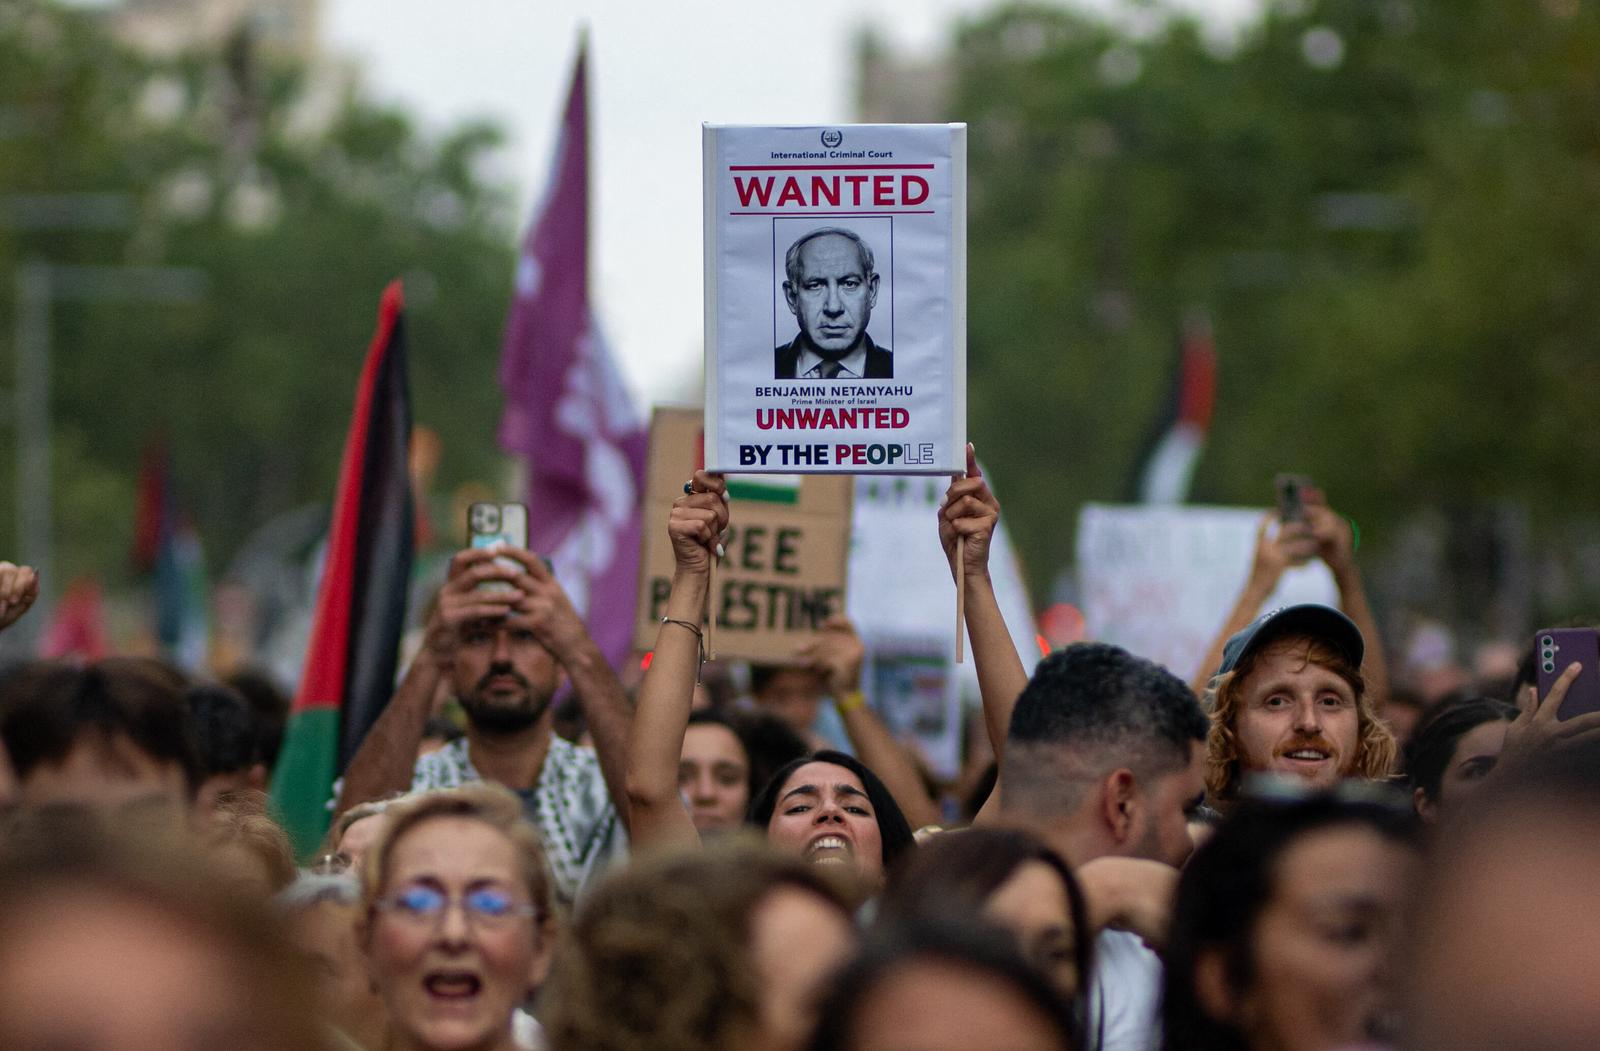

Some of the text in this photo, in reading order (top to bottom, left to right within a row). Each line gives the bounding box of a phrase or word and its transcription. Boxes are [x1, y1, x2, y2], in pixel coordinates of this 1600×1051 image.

[771, 150, 893, 159] International Criminal Court
[733, 175, 930, 207] WANTED
[755, 385, 913, 397] BENJAMIN NETANYAHU
[756, 407, 910, 430] UNWANTED
[739, 443, 934, 466] BY THE PEOPLE
